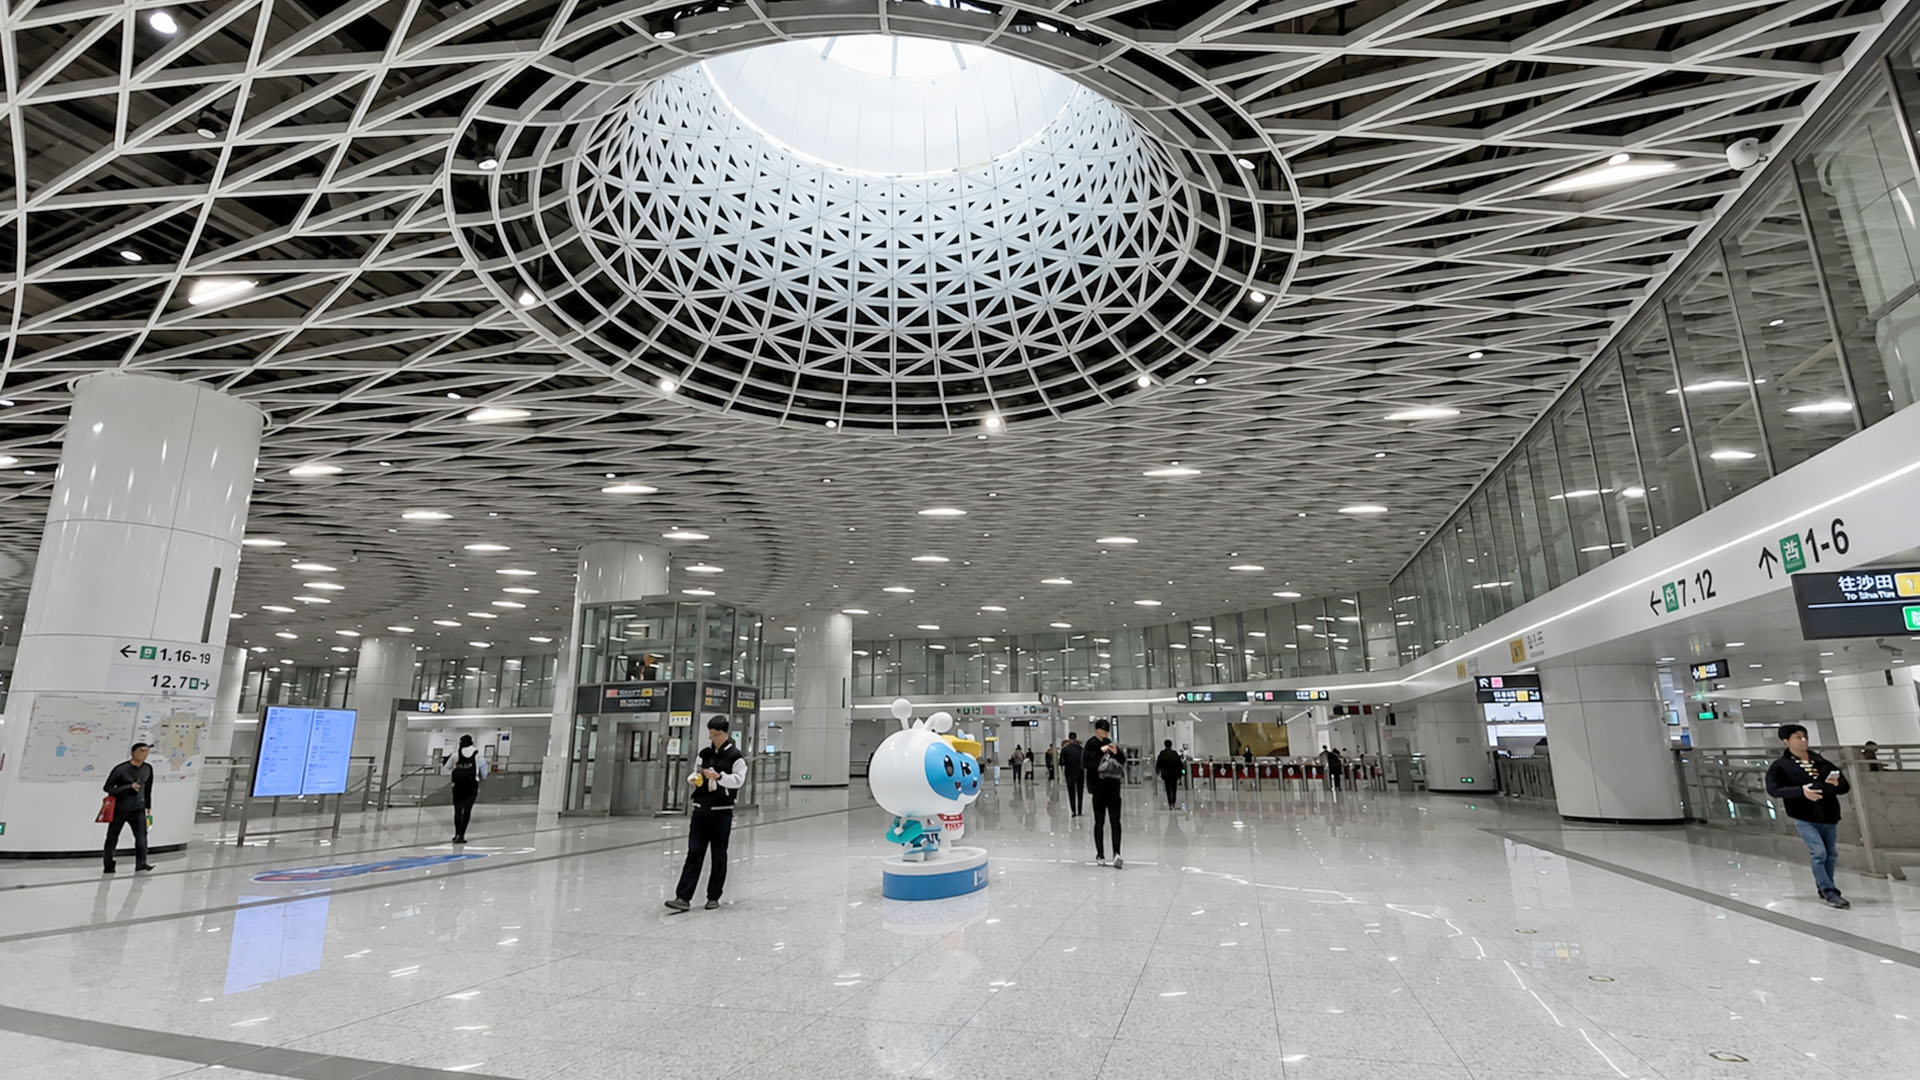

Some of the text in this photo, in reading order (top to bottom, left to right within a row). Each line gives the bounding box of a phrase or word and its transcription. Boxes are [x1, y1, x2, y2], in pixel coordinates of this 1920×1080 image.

[1805, 518, 1850, 563] 1-6
[1677, 568, 1717, 607] 7.12
[1837, 574, 1894, 592] 往沙田
[150, 674, 188, 689] 12.7
